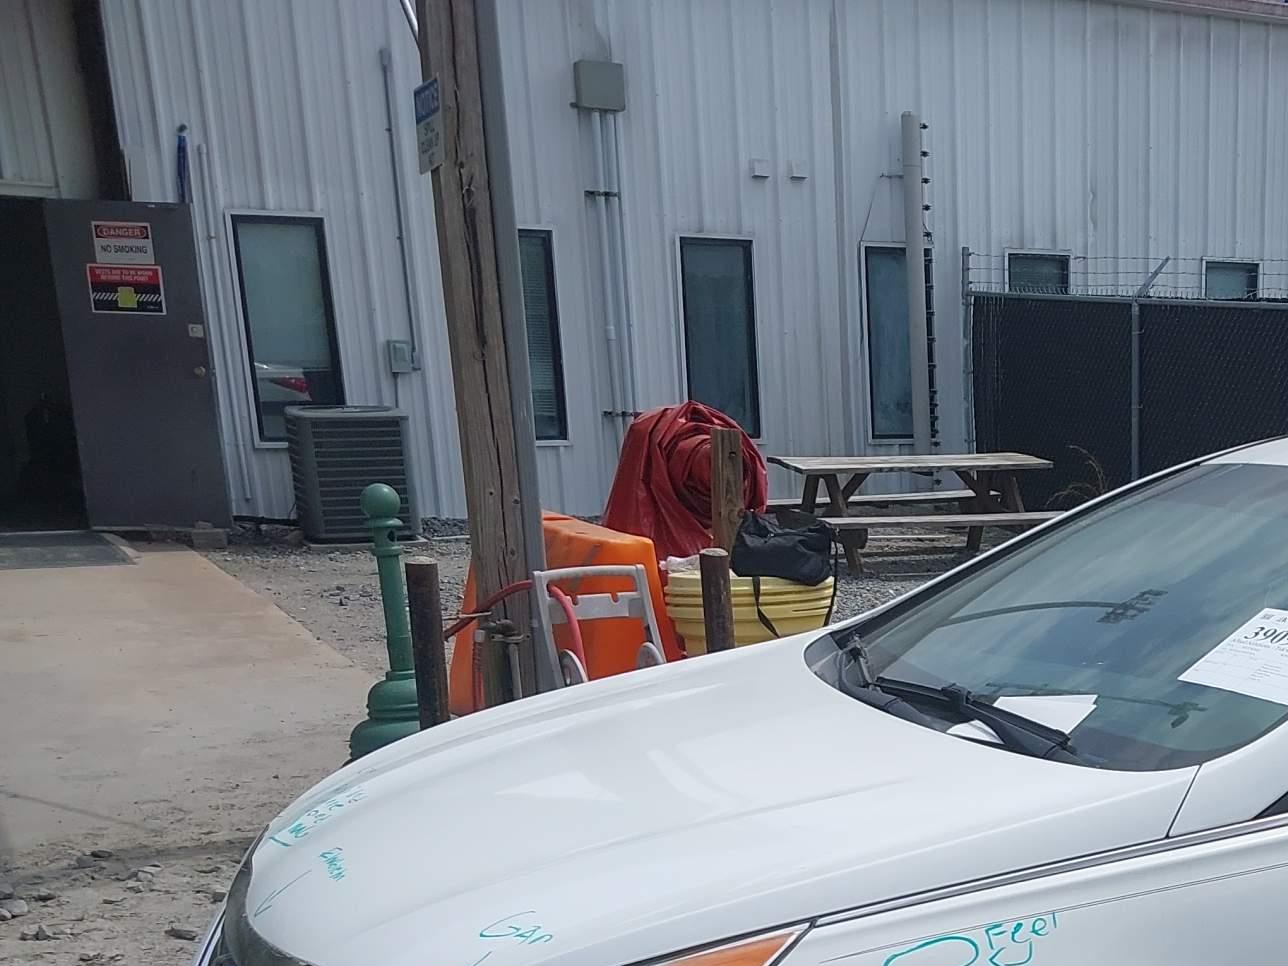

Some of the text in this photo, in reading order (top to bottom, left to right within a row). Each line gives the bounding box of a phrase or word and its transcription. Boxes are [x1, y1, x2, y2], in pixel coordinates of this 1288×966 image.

[102, 227, 141, 237] DANGER
[101, 244, 148, 254] NO SMOKING
